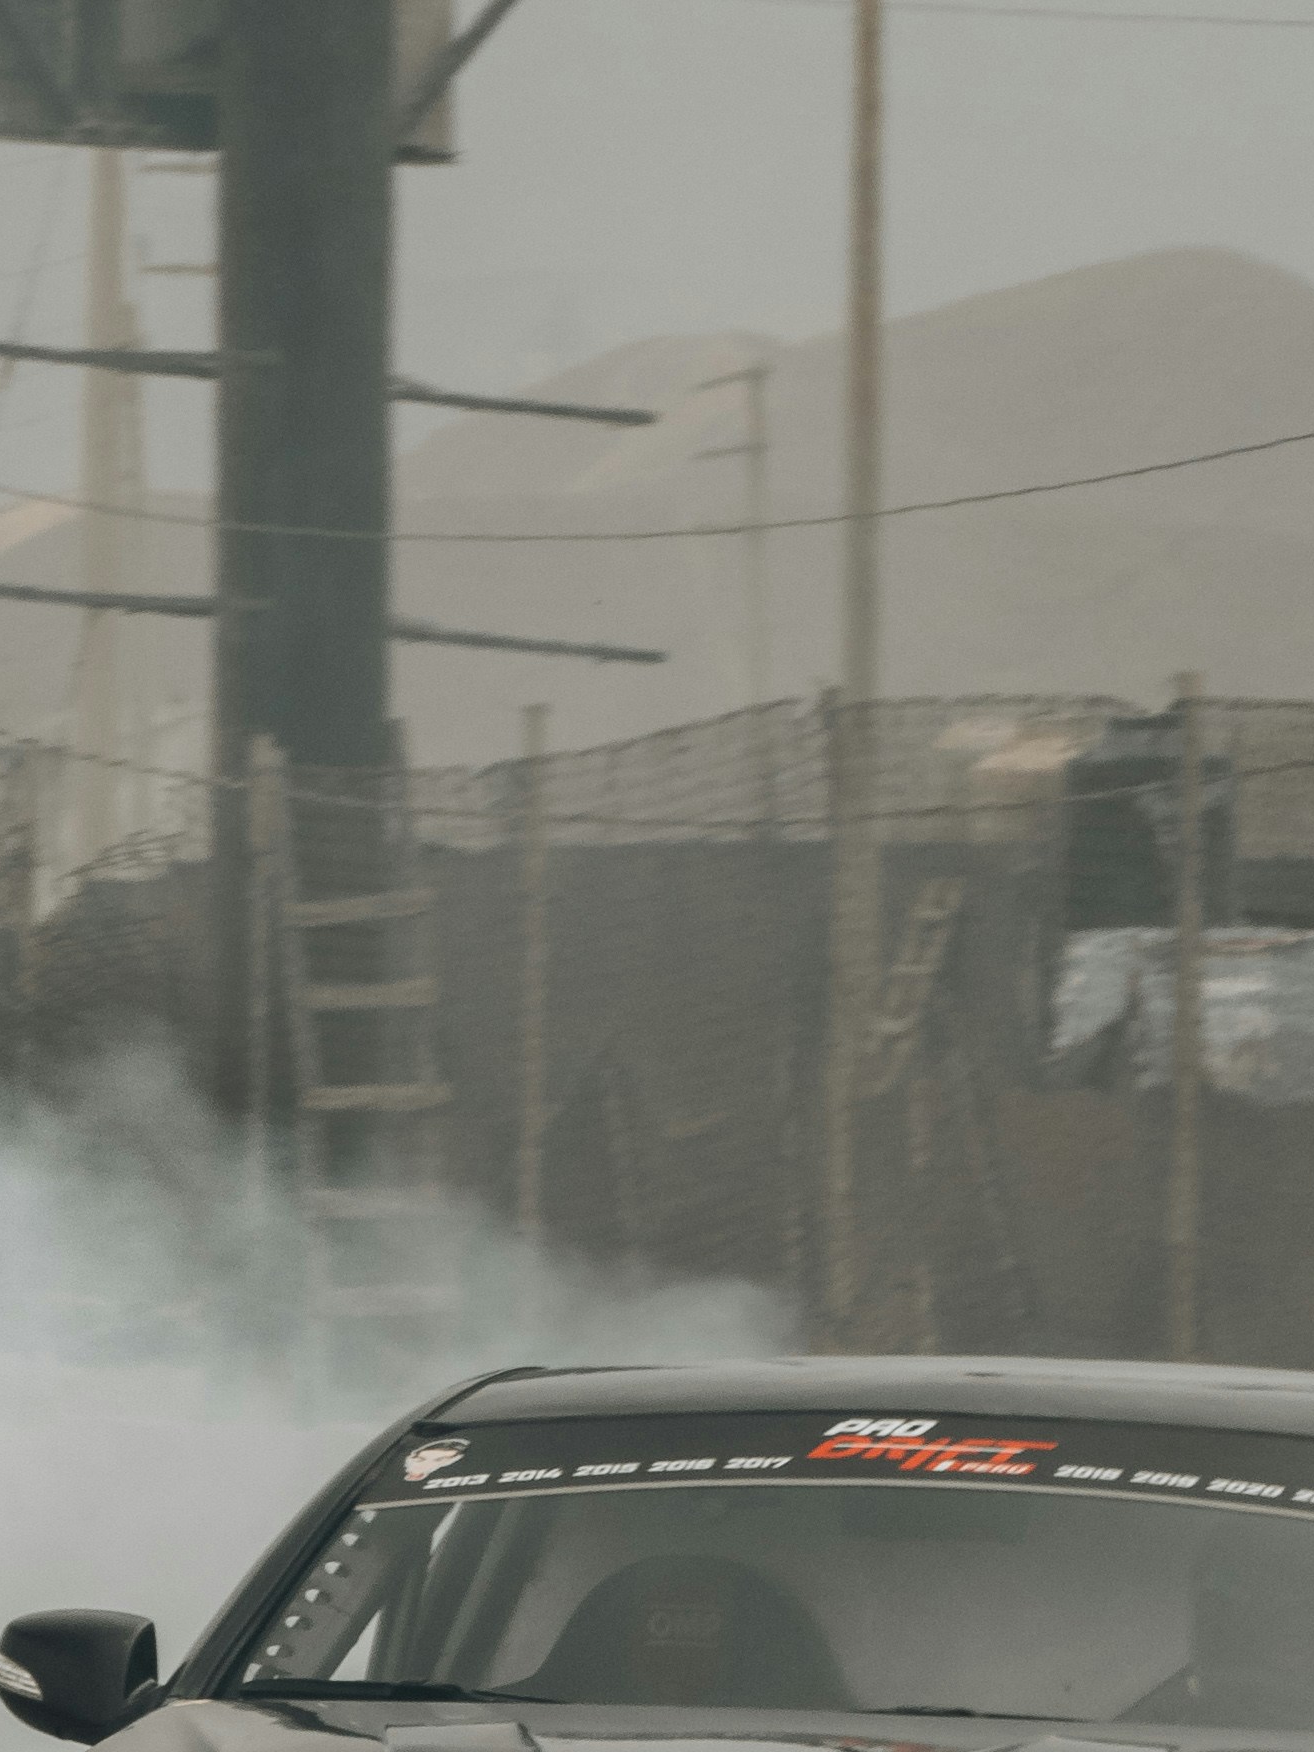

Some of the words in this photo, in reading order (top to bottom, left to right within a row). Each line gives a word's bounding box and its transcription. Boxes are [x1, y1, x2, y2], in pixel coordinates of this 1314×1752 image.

[807, 1434, 1059, 1472] DRIFT
[423, 1473, 490, 1490] 2013
[498, 1468, 564, 1483] 2014
[572, 1462, 641, 1477] 2015
[647, 1458, 717, 1472] 2016
[723, 1457, 794, 1469] 2017
[1053, 1464, 1124, 1481] 2018
[1130, 1470, 1201, 1489] 2019
[1205, 1478, 1287, 1498] 2020
